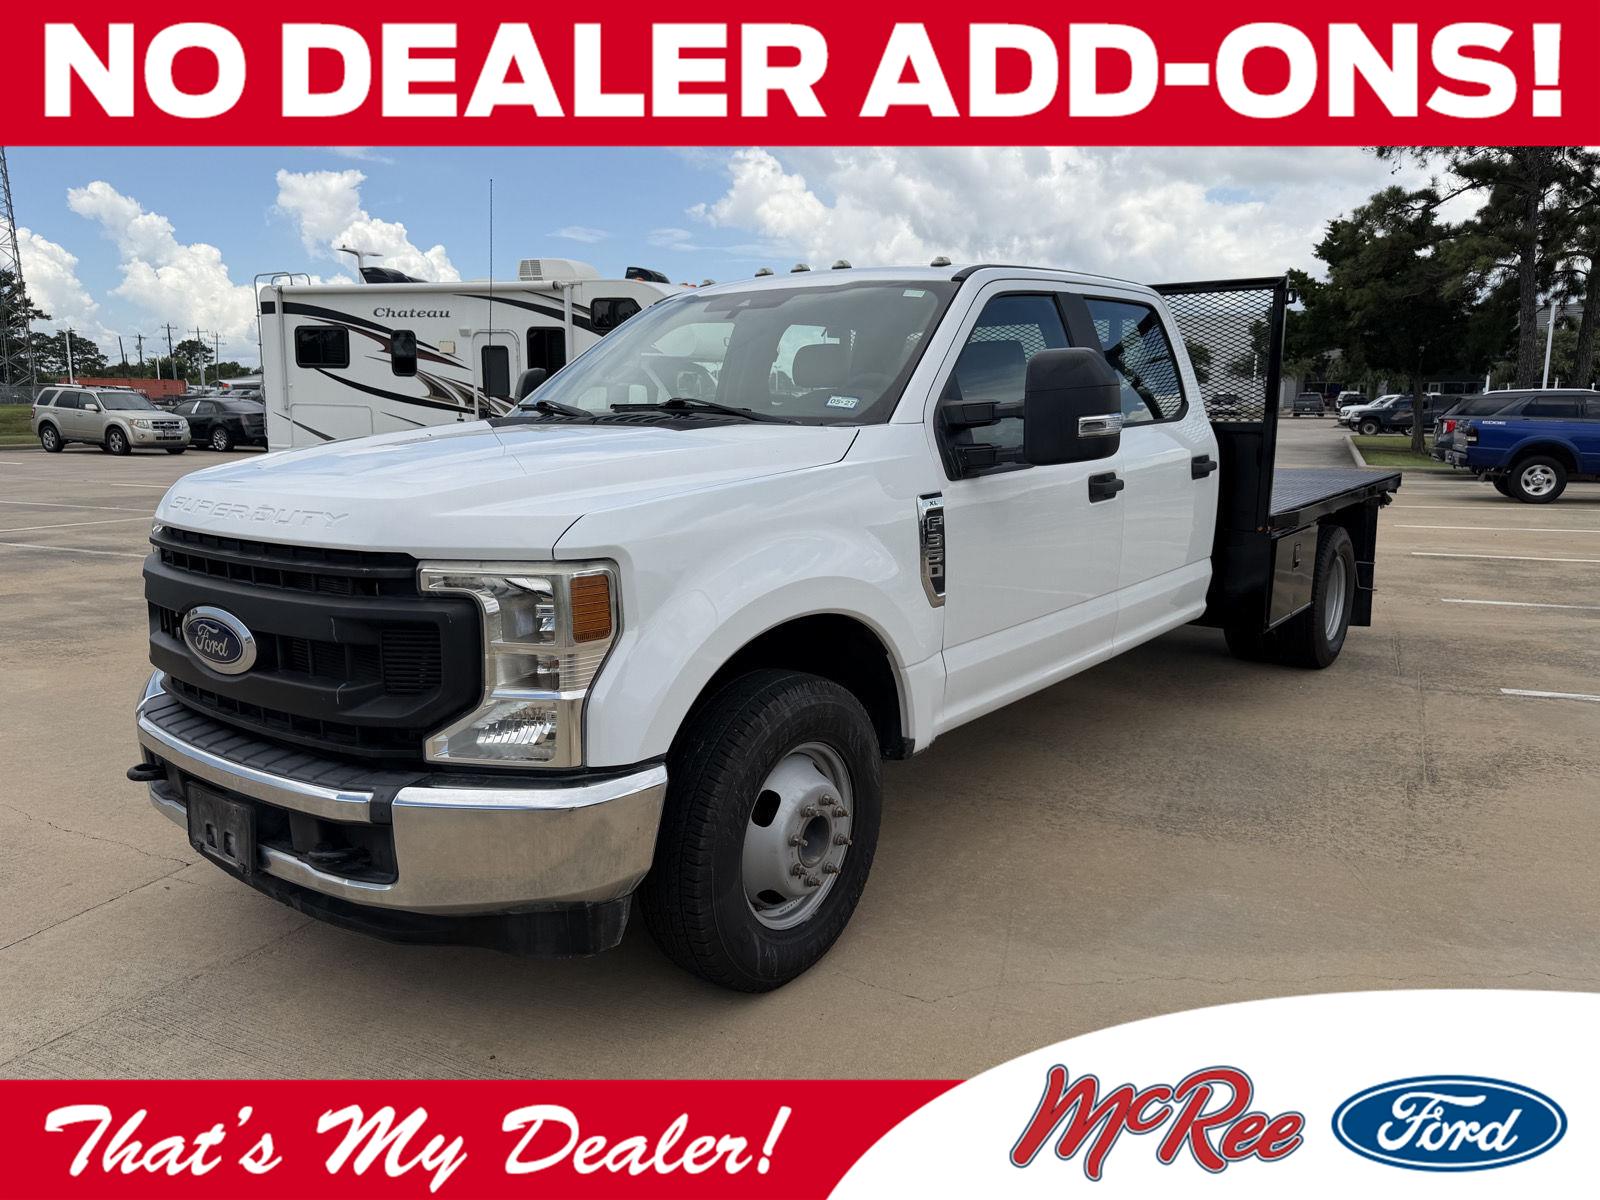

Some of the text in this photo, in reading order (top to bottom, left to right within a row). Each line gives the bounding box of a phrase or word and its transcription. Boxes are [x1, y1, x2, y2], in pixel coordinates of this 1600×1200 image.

[373, 307, 451, 319] Chateau
[169, 495, 350, 529] SUPER DUTY
[195, 623, 229, 657] Ford
